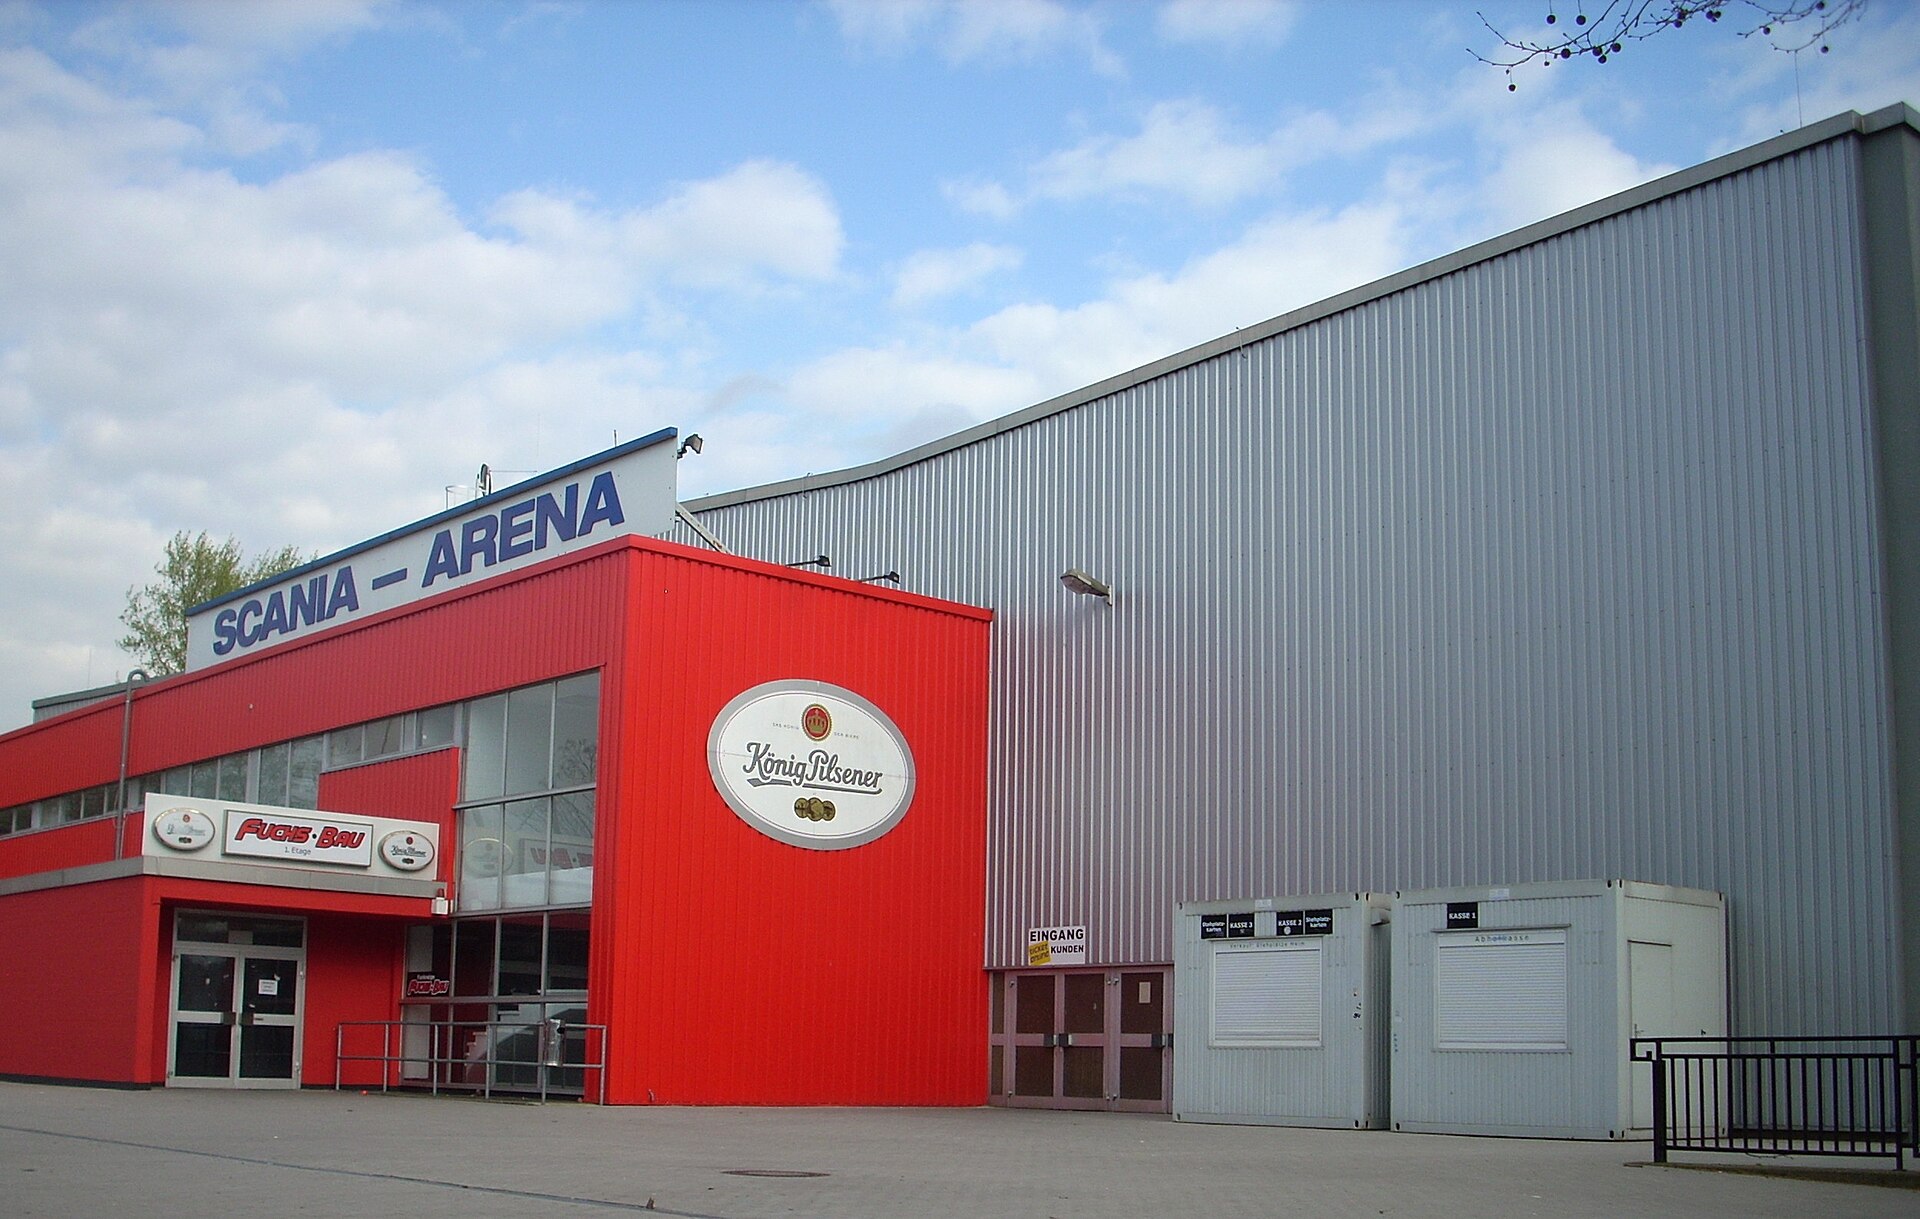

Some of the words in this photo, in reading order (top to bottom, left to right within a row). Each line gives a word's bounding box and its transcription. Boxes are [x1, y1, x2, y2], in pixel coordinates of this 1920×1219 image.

[213, 566, 359, 656] SCANIA
[421, 471, 625, 588] ARENA
[743, 742, 807, 786] König
[805, 749, 883, 789] Pilsener
[291, 847, 311, 856] Etage
[1278, 919, 1297, 927] KASSE
[1030, 929, 1084, 941] EINGANG
[1051, 945, 1084, 954] KUNDEN
